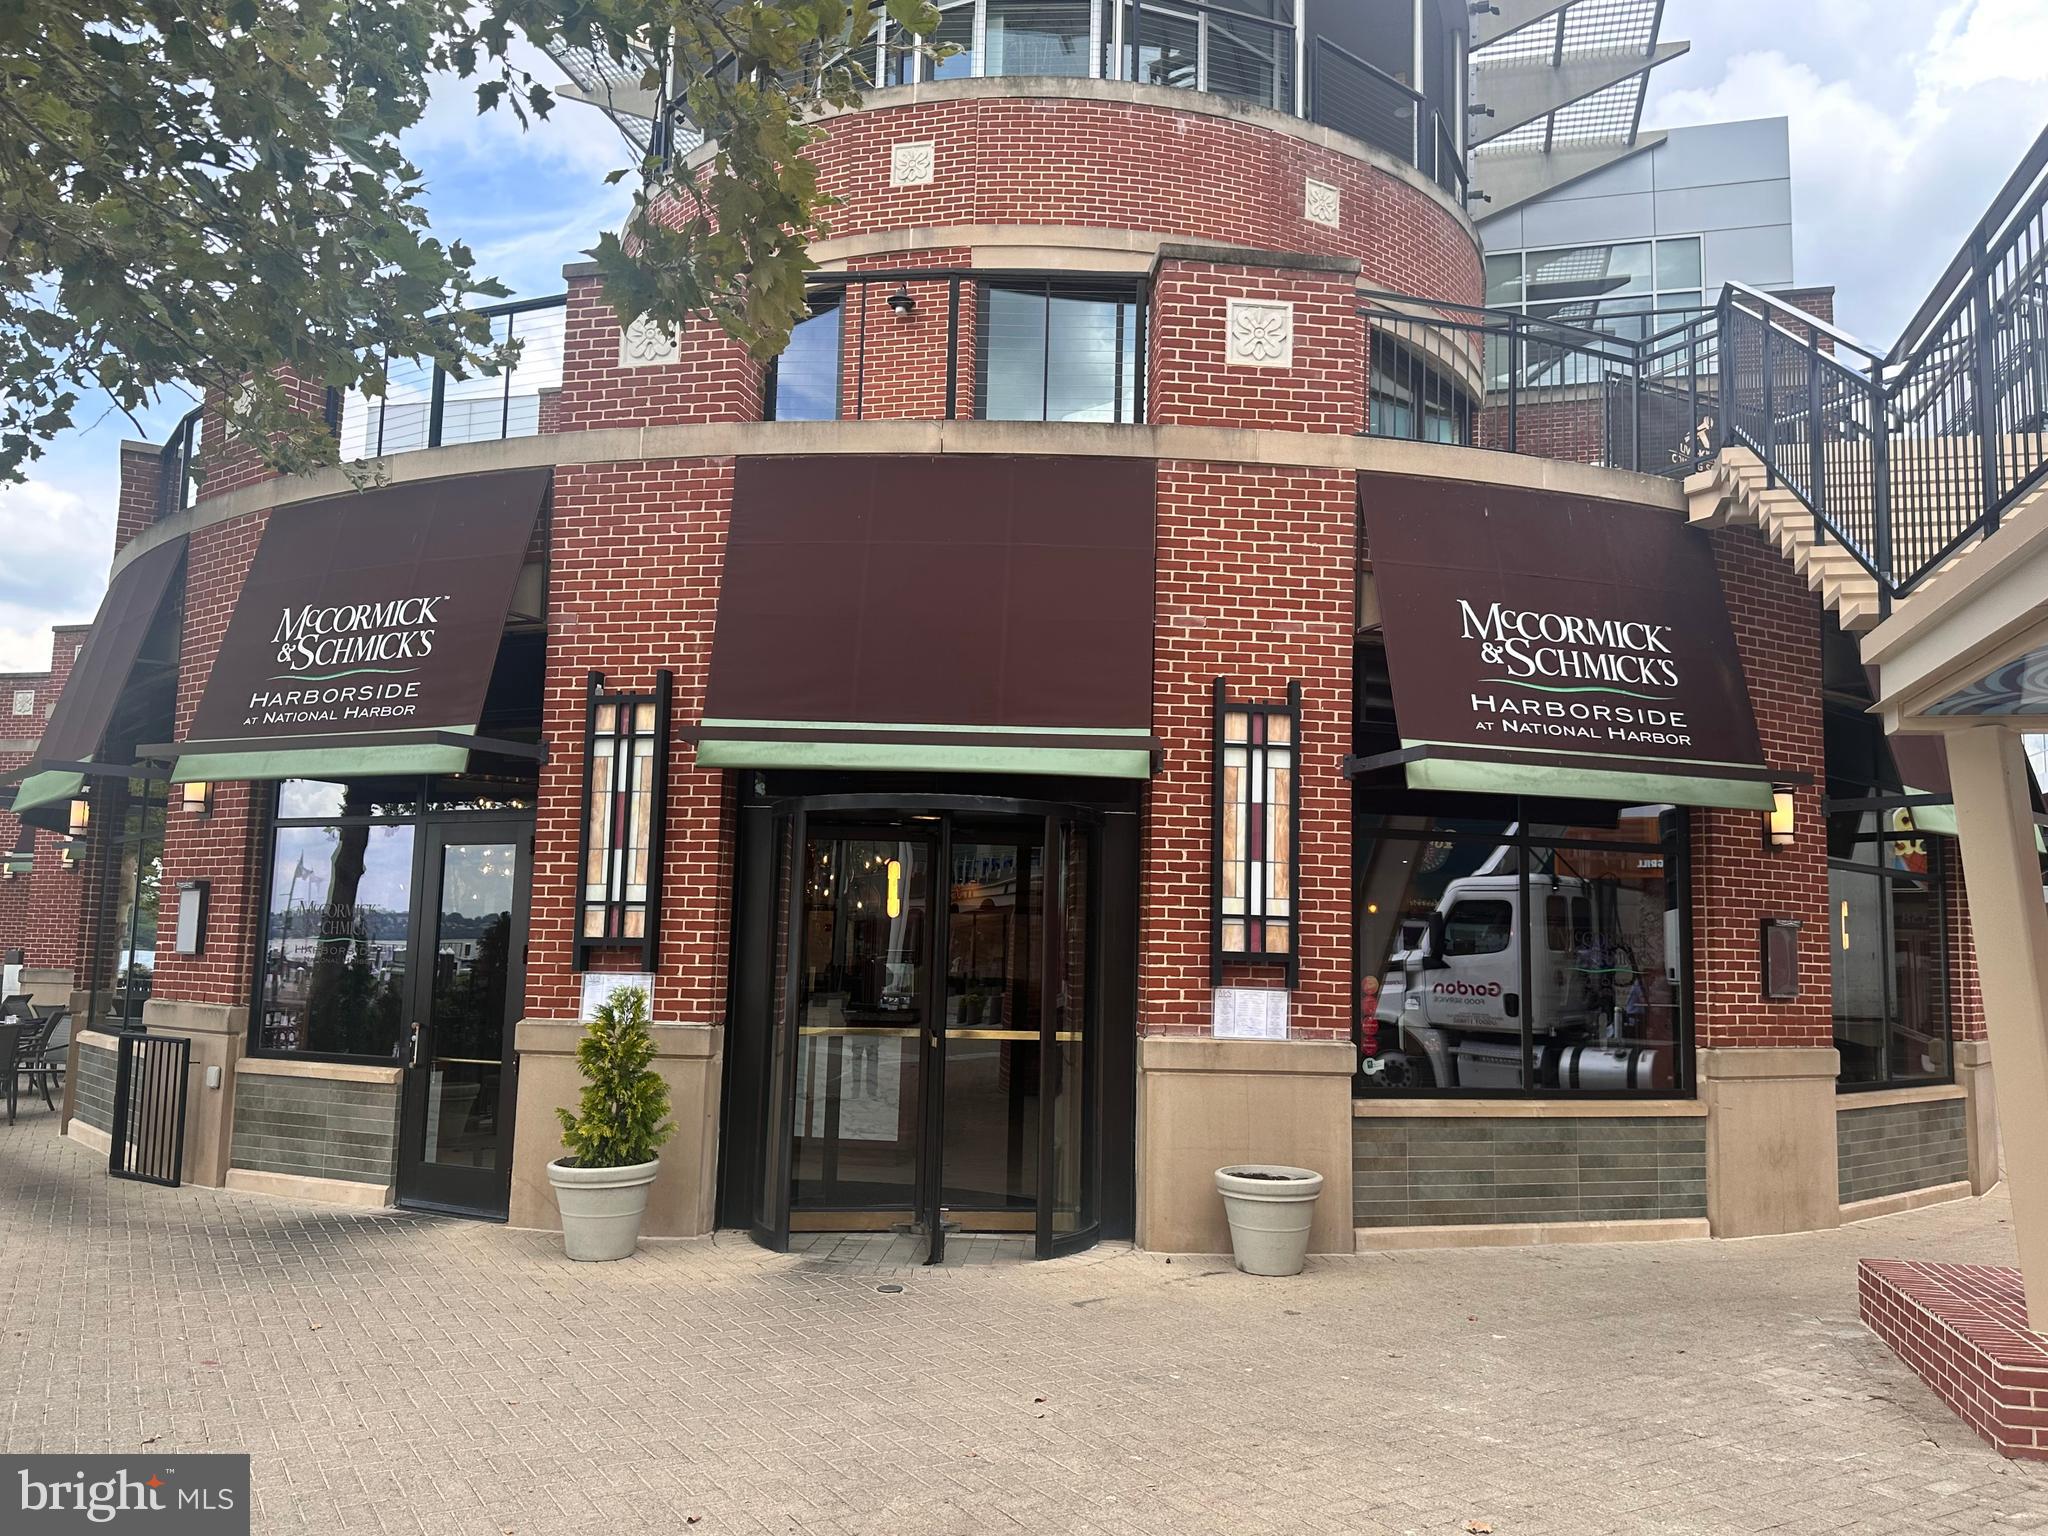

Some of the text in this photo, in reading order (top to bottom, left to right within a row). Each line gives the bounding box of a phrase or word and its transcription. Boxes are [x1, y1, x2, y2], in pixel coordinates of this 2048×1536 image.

[249, 682, 422, 709] HARBORSIDE
[243, 704, 416, 725] AT NATIONAL HARBOR
[1471, 693, 1688, 728] HARBORSIDE
[1475, 719, 1692, 746] AT NATIONAL HARBOR
